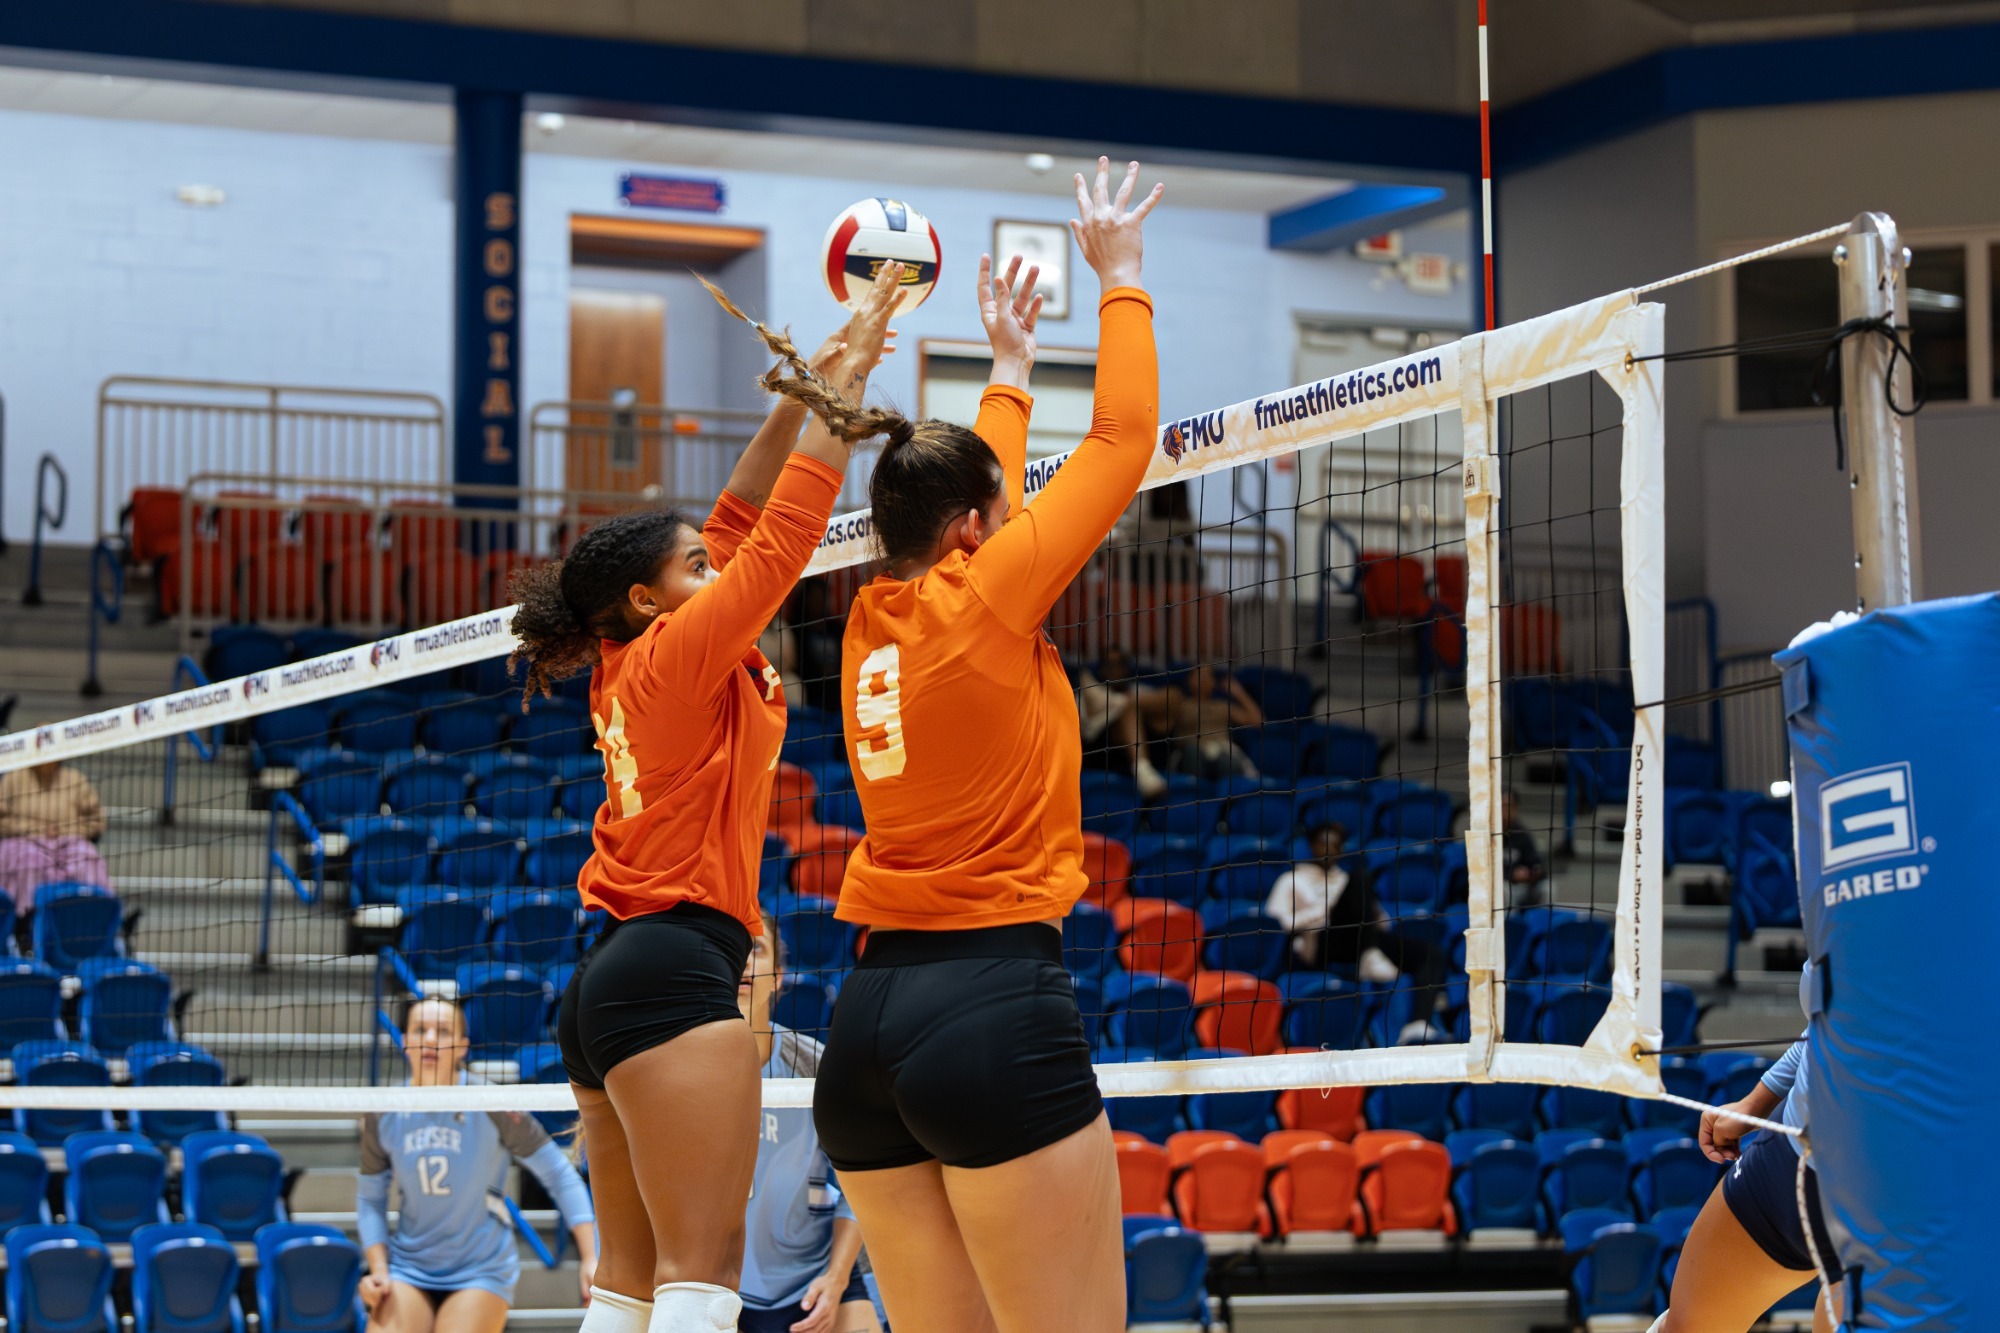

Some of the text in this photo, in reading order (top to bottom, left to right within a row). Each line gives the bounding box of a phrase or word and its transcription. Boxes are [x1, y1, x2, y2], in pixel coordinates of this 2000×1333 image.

[481, 192, 515, 464] SOCIAL
[1180, 356, 1442, 453] FMU fmuathletics.com
[378, 638, 401, 664] FMU
[415, 617, 502, 653] fmuathletics.com
[856, 642, 907, 781] 9
[416, 1153, 452, 1196] 12
